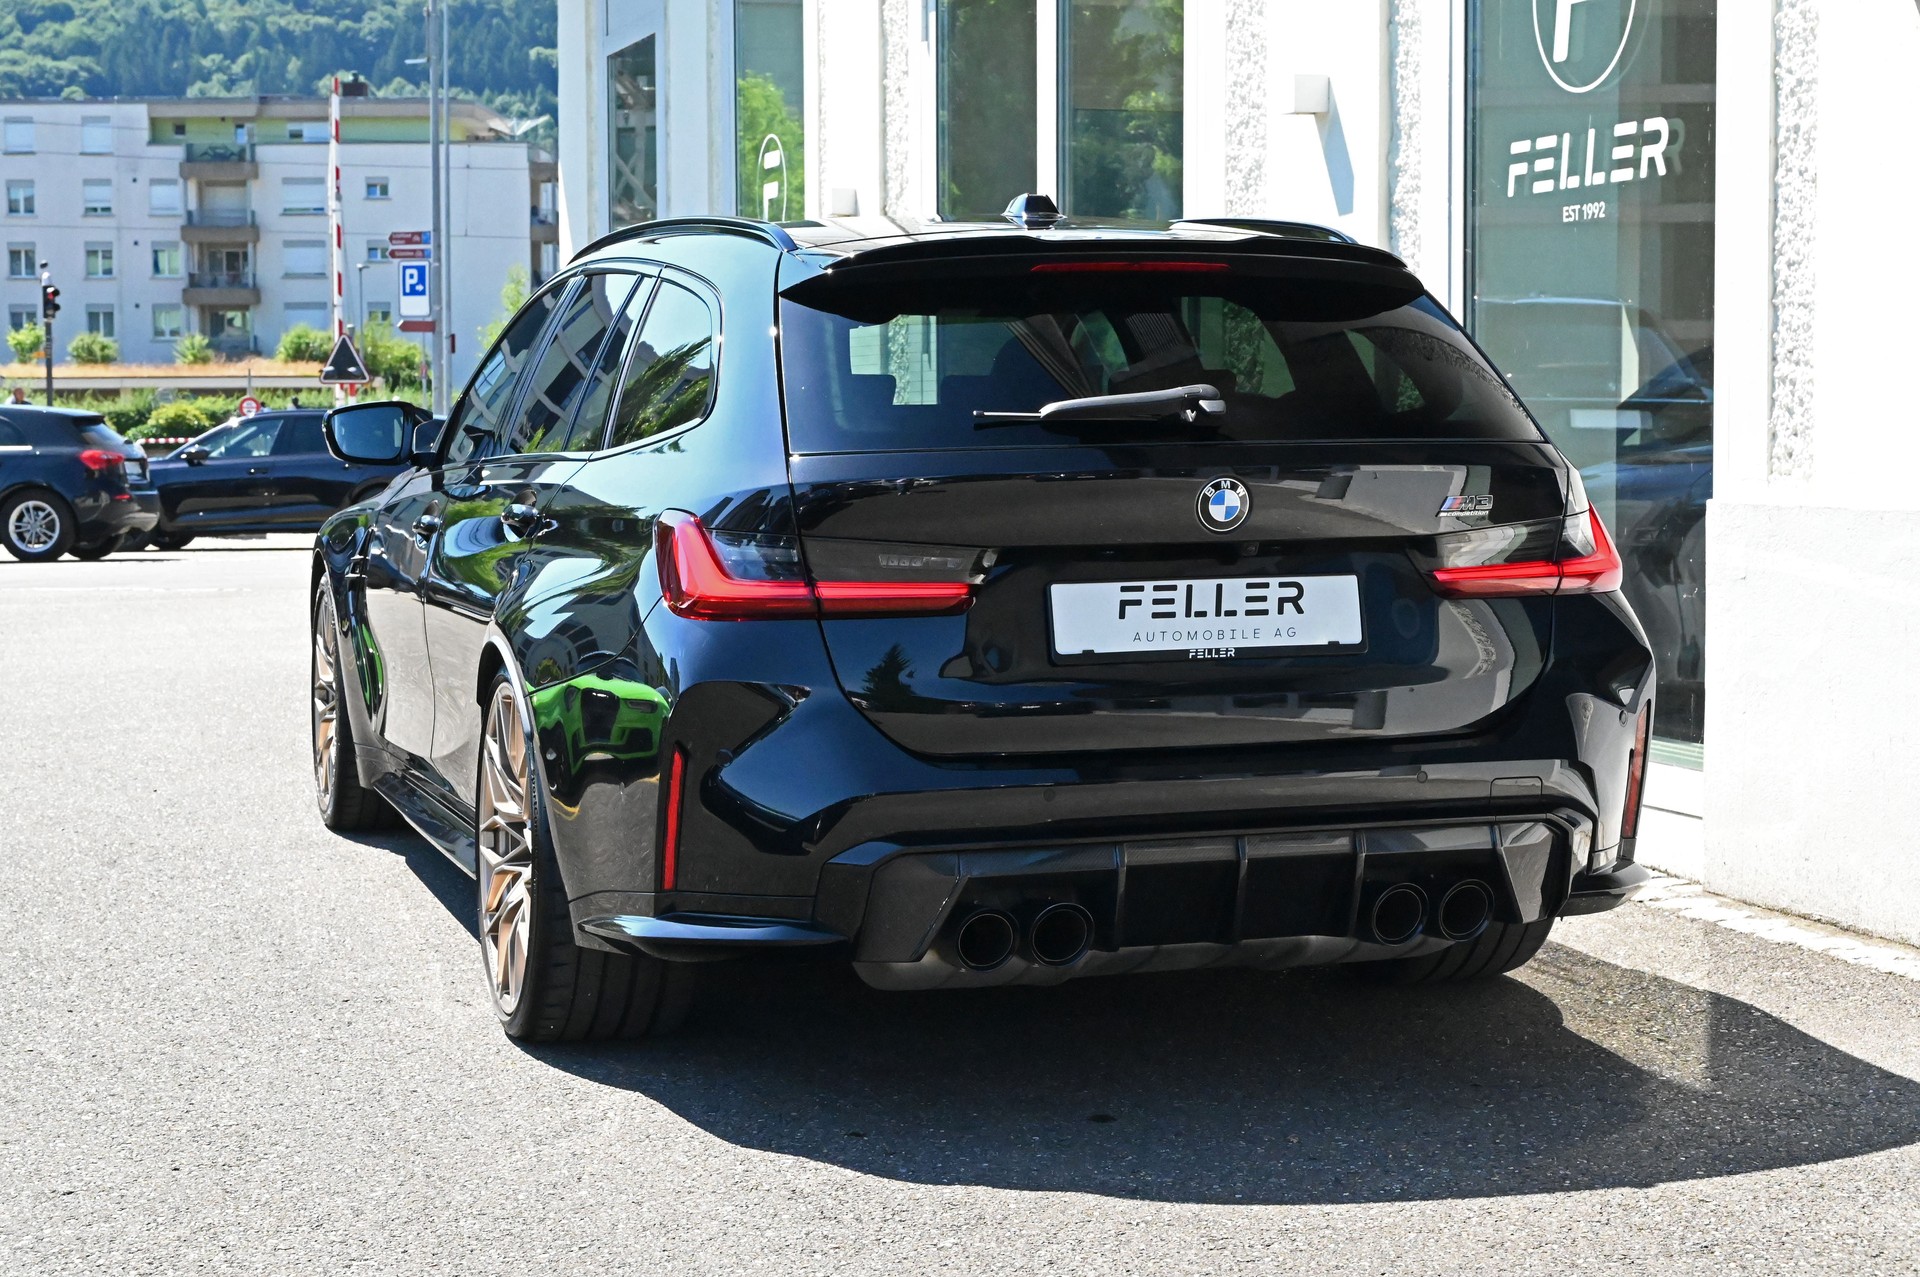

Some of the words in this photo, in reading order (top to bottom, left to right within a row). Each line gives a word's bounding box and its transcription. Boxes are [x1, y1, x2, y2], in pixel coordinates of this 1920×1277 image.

[1507, 116, 1669, 198] FELLER
[1562, 204, 1581, 223] EST
[1582, 201, 1606, 220] 1992
[405, 268, 418, 294] P
[1204, 480, 1246, 498] BMW
[1441, 494, 1494, 510] M3
[1118, 581, 1304, 620] FELLER
[1132, 628, 1261, 643] AUTOMOBILE
[1273, 627, 1298, 638] AG
[1189, 647, 1235, 659] FELLER
